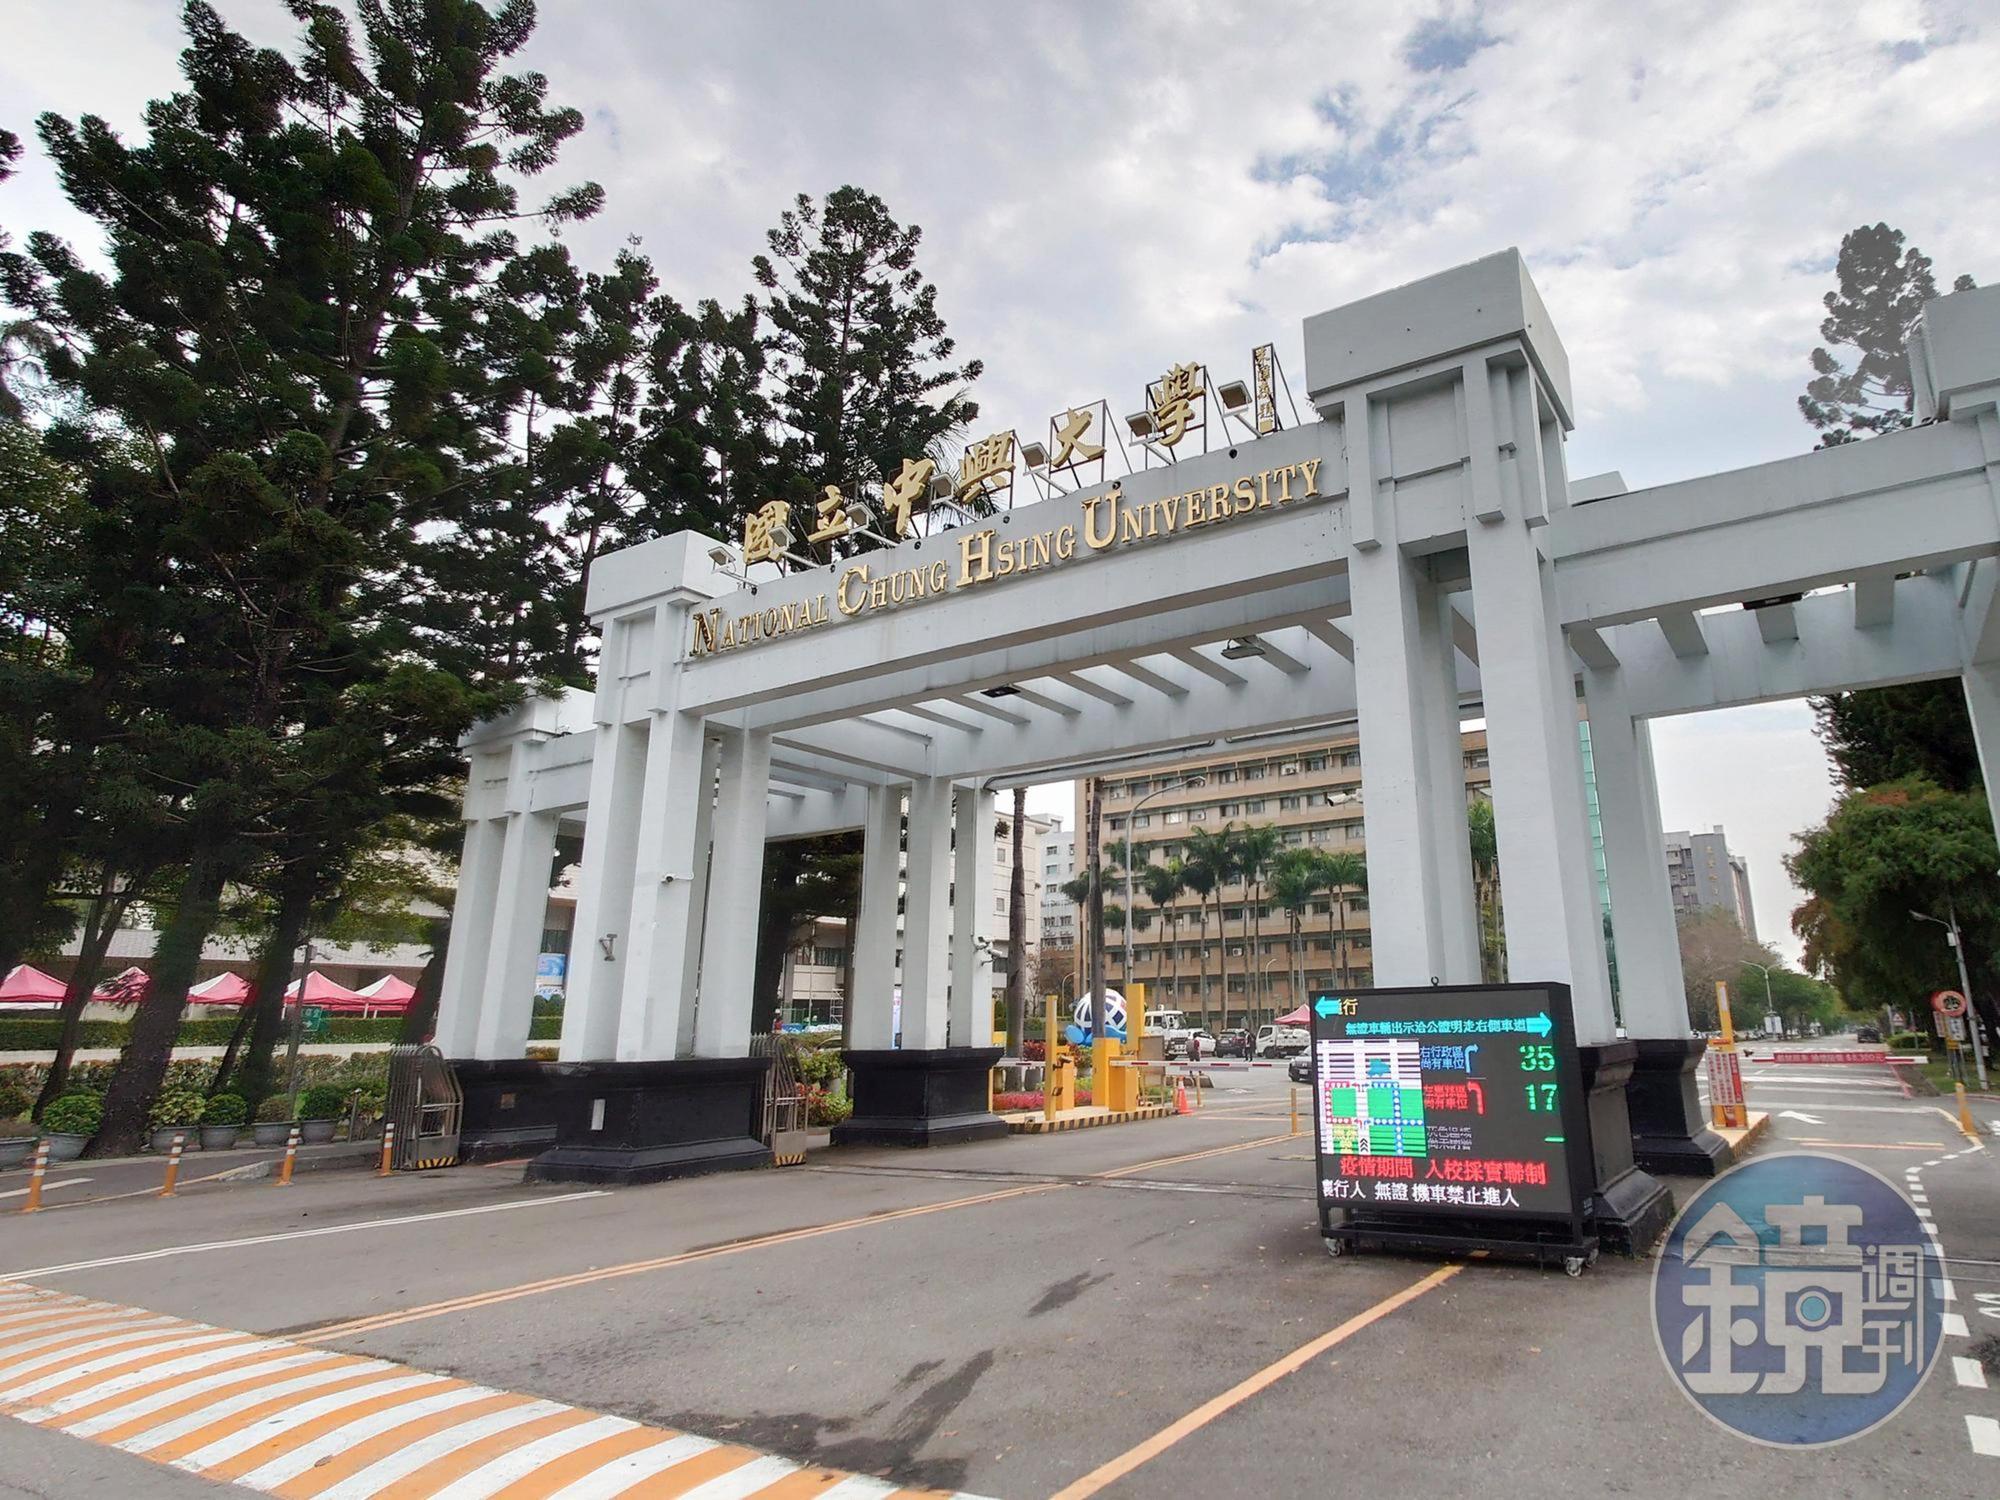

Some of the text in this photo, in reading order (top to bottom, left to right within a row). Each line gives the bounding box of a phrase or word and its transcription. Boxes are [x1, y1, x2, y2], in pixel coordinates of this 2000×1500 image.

[743, 362, 1206, 565] 國立中興大學
[691, 457, 1322, 657] NATIONAL CHUNG HSING UNIVERSITY
[1421, 1058, 1465, 1070] 尚有車位
[1519, 1045, 1556, 1072] 35
[1524, 1084, 1558, 1111] 17
[1340, 1156, 1547, 1185] 疫情期間 入校採實聯制
[1412, 1183, 1520, 1207] 機車禁止進入
